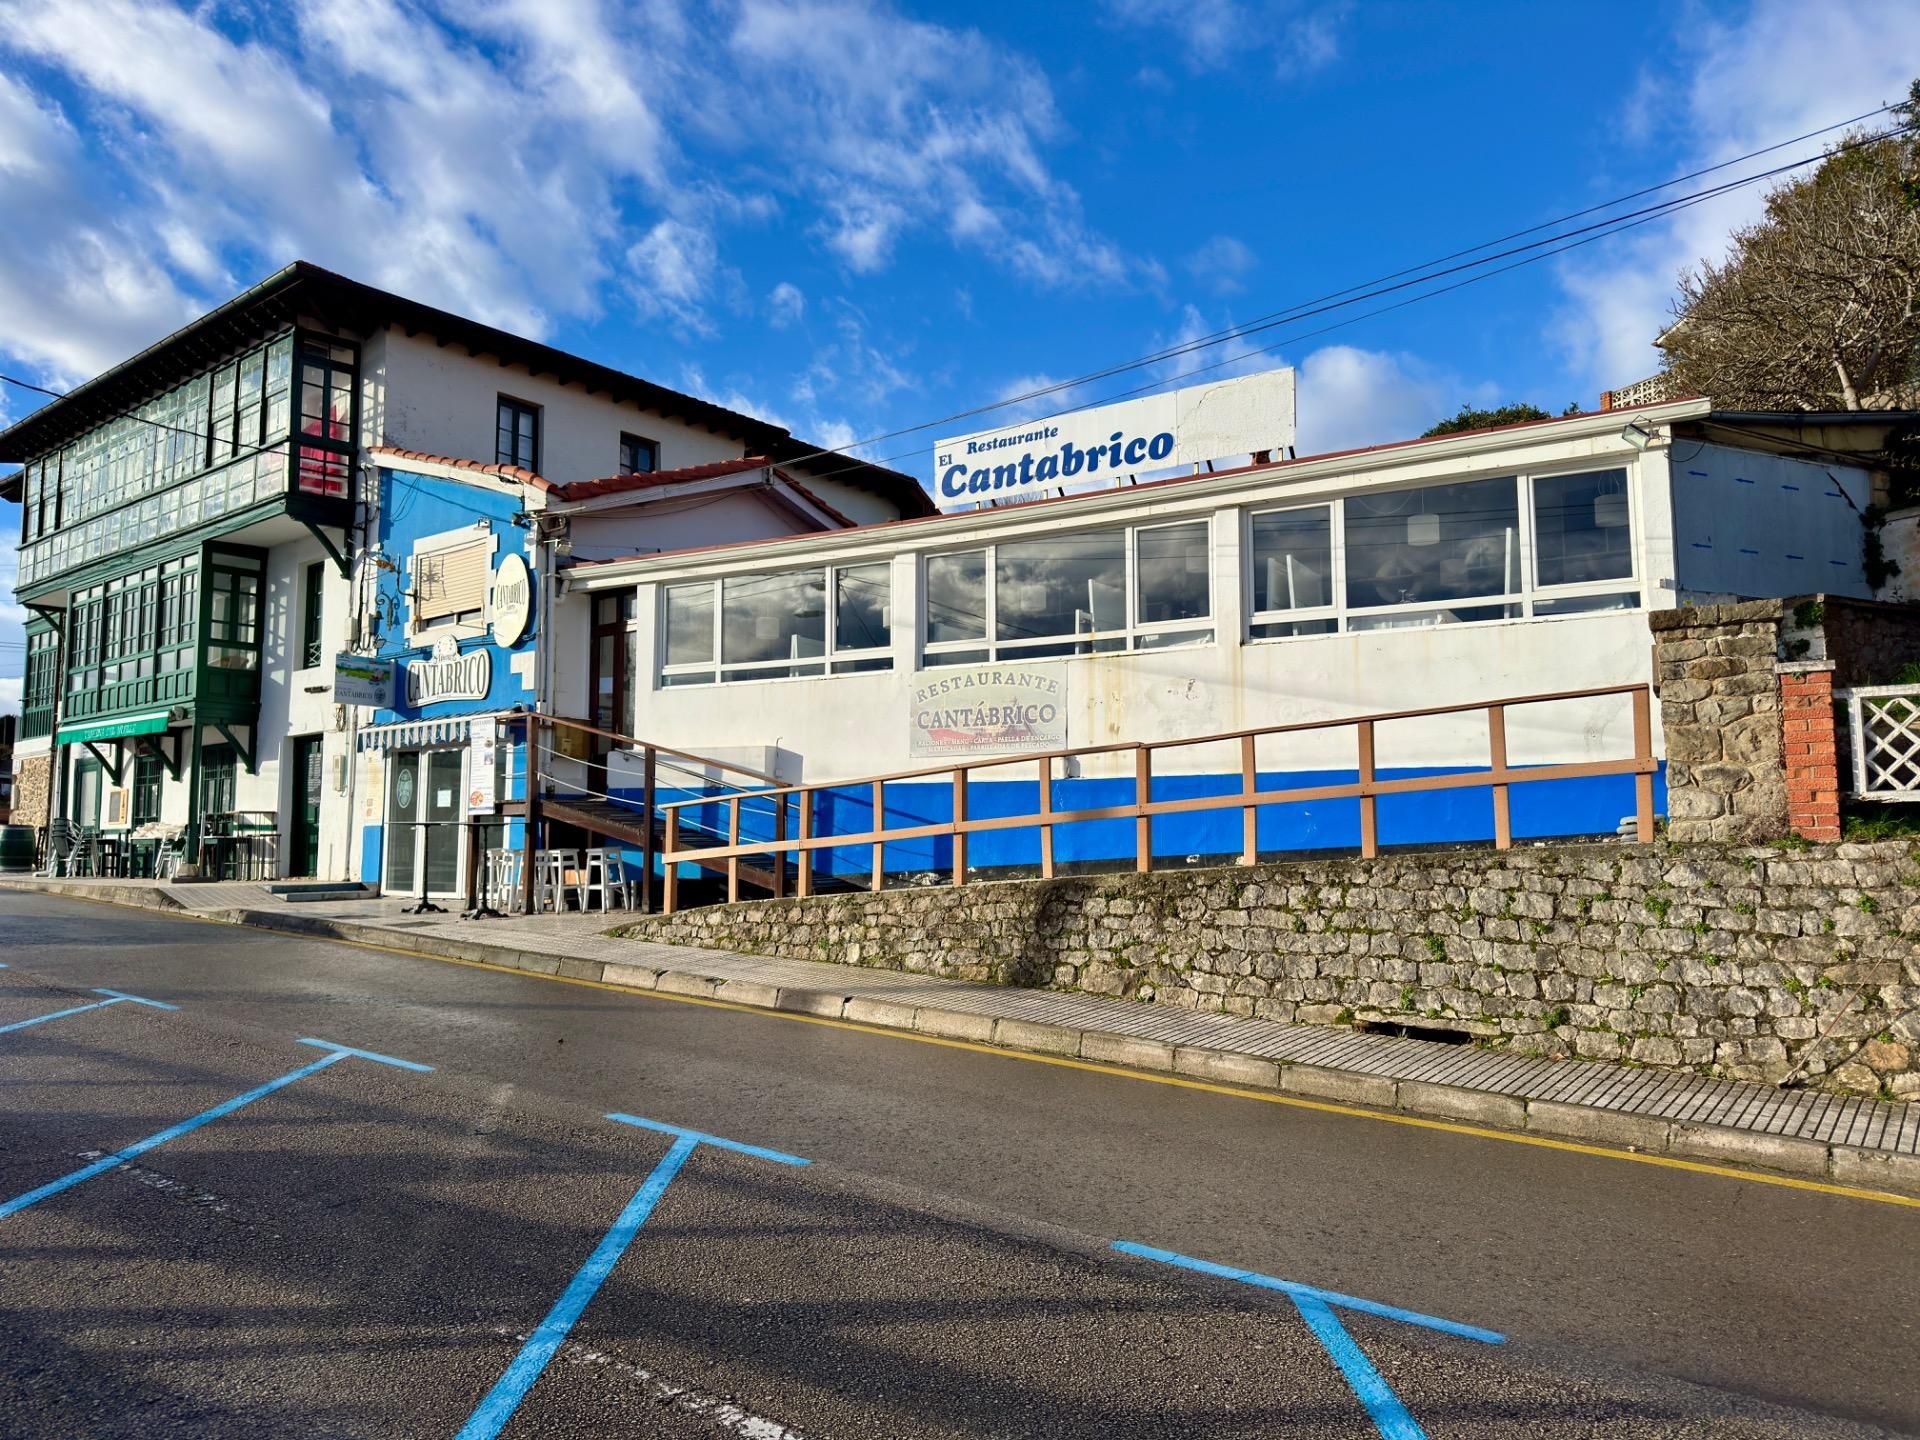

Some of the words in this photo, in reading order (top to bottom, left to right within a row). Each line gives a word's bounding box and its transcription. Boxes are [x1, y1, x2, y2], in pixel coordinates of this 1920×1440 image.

[967, 425, 1059, 455] Restaurante
[938, 454, 953, 468] El
[941, 431, 1175, 498] Cantabrico
[916, 671, 1059, 703] RESTAURANTE
[917, 701, 1057, 730] CANTÁBRICO
